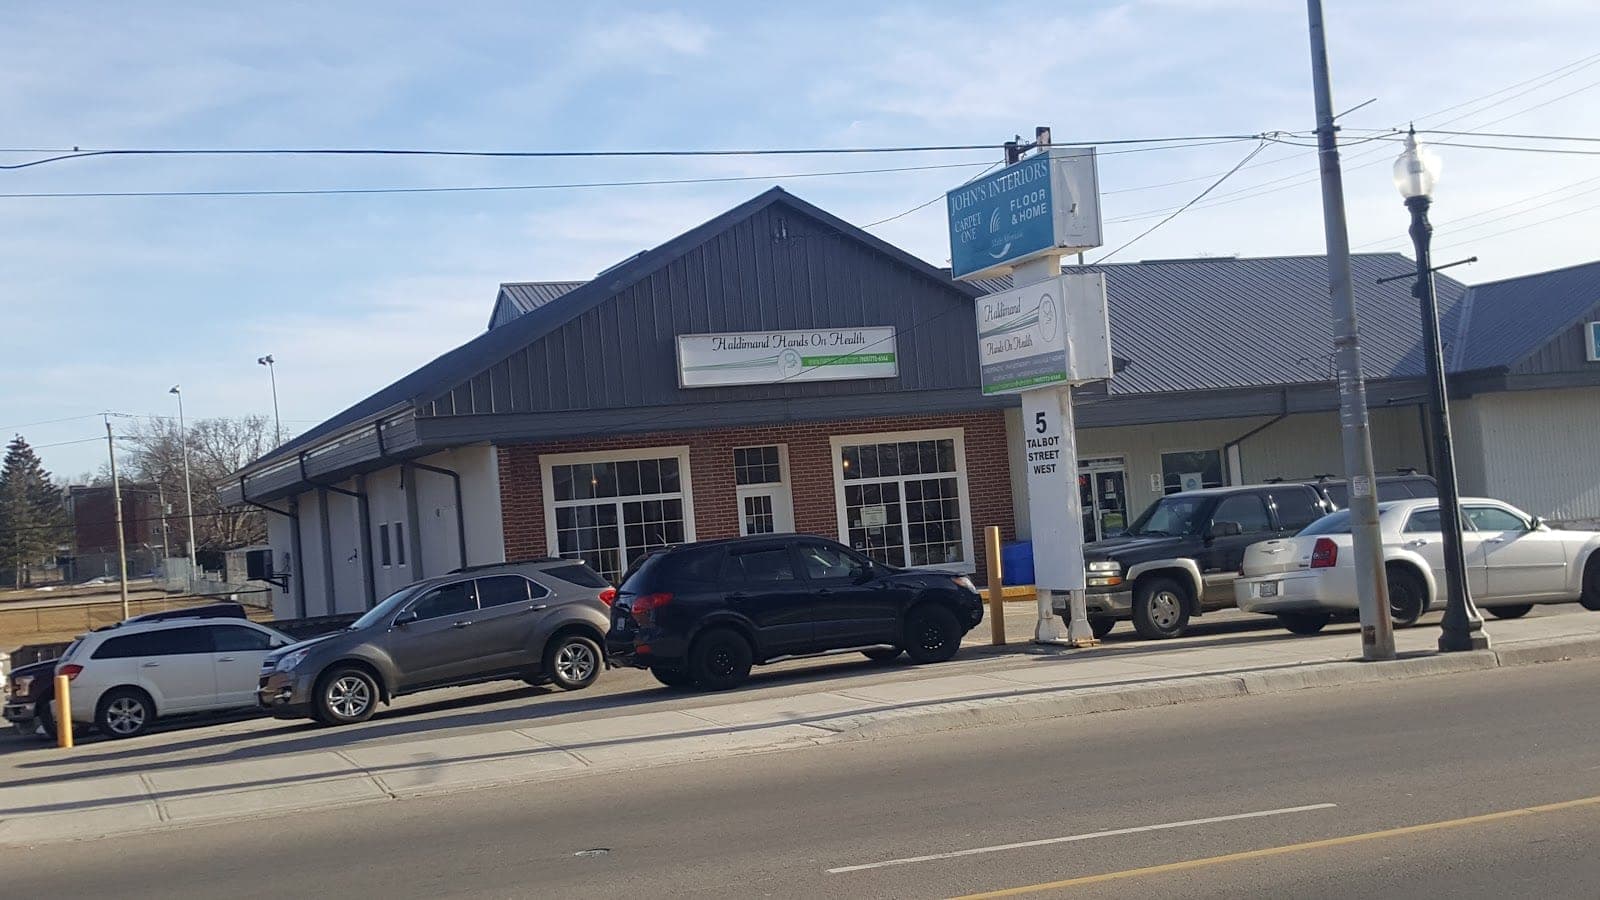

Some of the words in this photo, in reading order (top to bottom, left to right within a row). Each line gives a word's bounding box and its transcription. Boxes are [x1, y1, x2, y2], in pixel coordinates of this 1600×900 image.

[951, 185, 987, 216] JOHN'S
[988, 160, 1048, 198] INTERIORS
[1010, 189, 1046, 212] FLOOR
[954, 212, 982, 233] CARPET
[1011, 214, 1018, 225] &
[1019, 203, 1047, 222] HOME
[961, 228, 977, 244] ONE
[984, 297, 1021, 322] Haldimand
[712, 335, 769, 351] Haldimand
[772, 334, 808, 349] Hands
[810, 333, 827, 347] On
[829, 332, 865, 346] Health
[1035, 411, 1047, 434] 5
[1026, 436, 1060, 448] TALBOT
[1028, 450, 1060, 462] STREET
[1033, 463, 1057, 474] WEST
